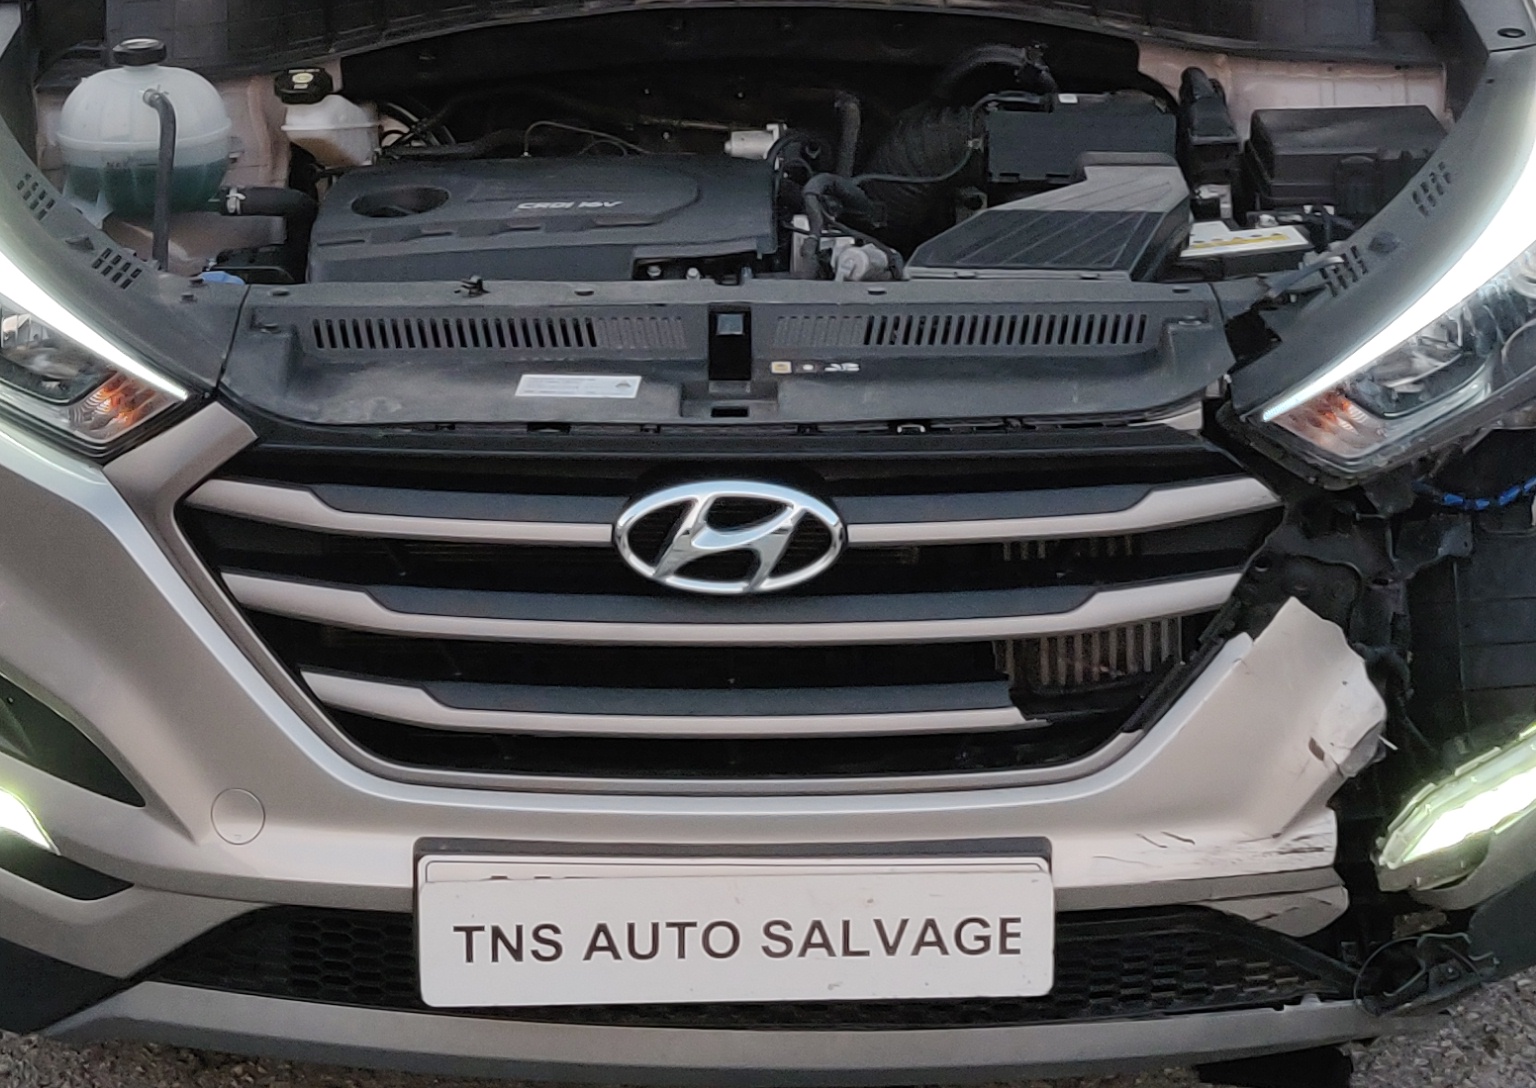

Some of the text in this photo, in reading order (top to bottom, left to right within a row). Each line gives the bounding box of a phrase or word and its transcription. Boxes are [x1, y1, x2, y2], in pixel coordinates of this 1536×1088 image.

[452, 916, 1022, 963] TNS AUTO SALVAGE
